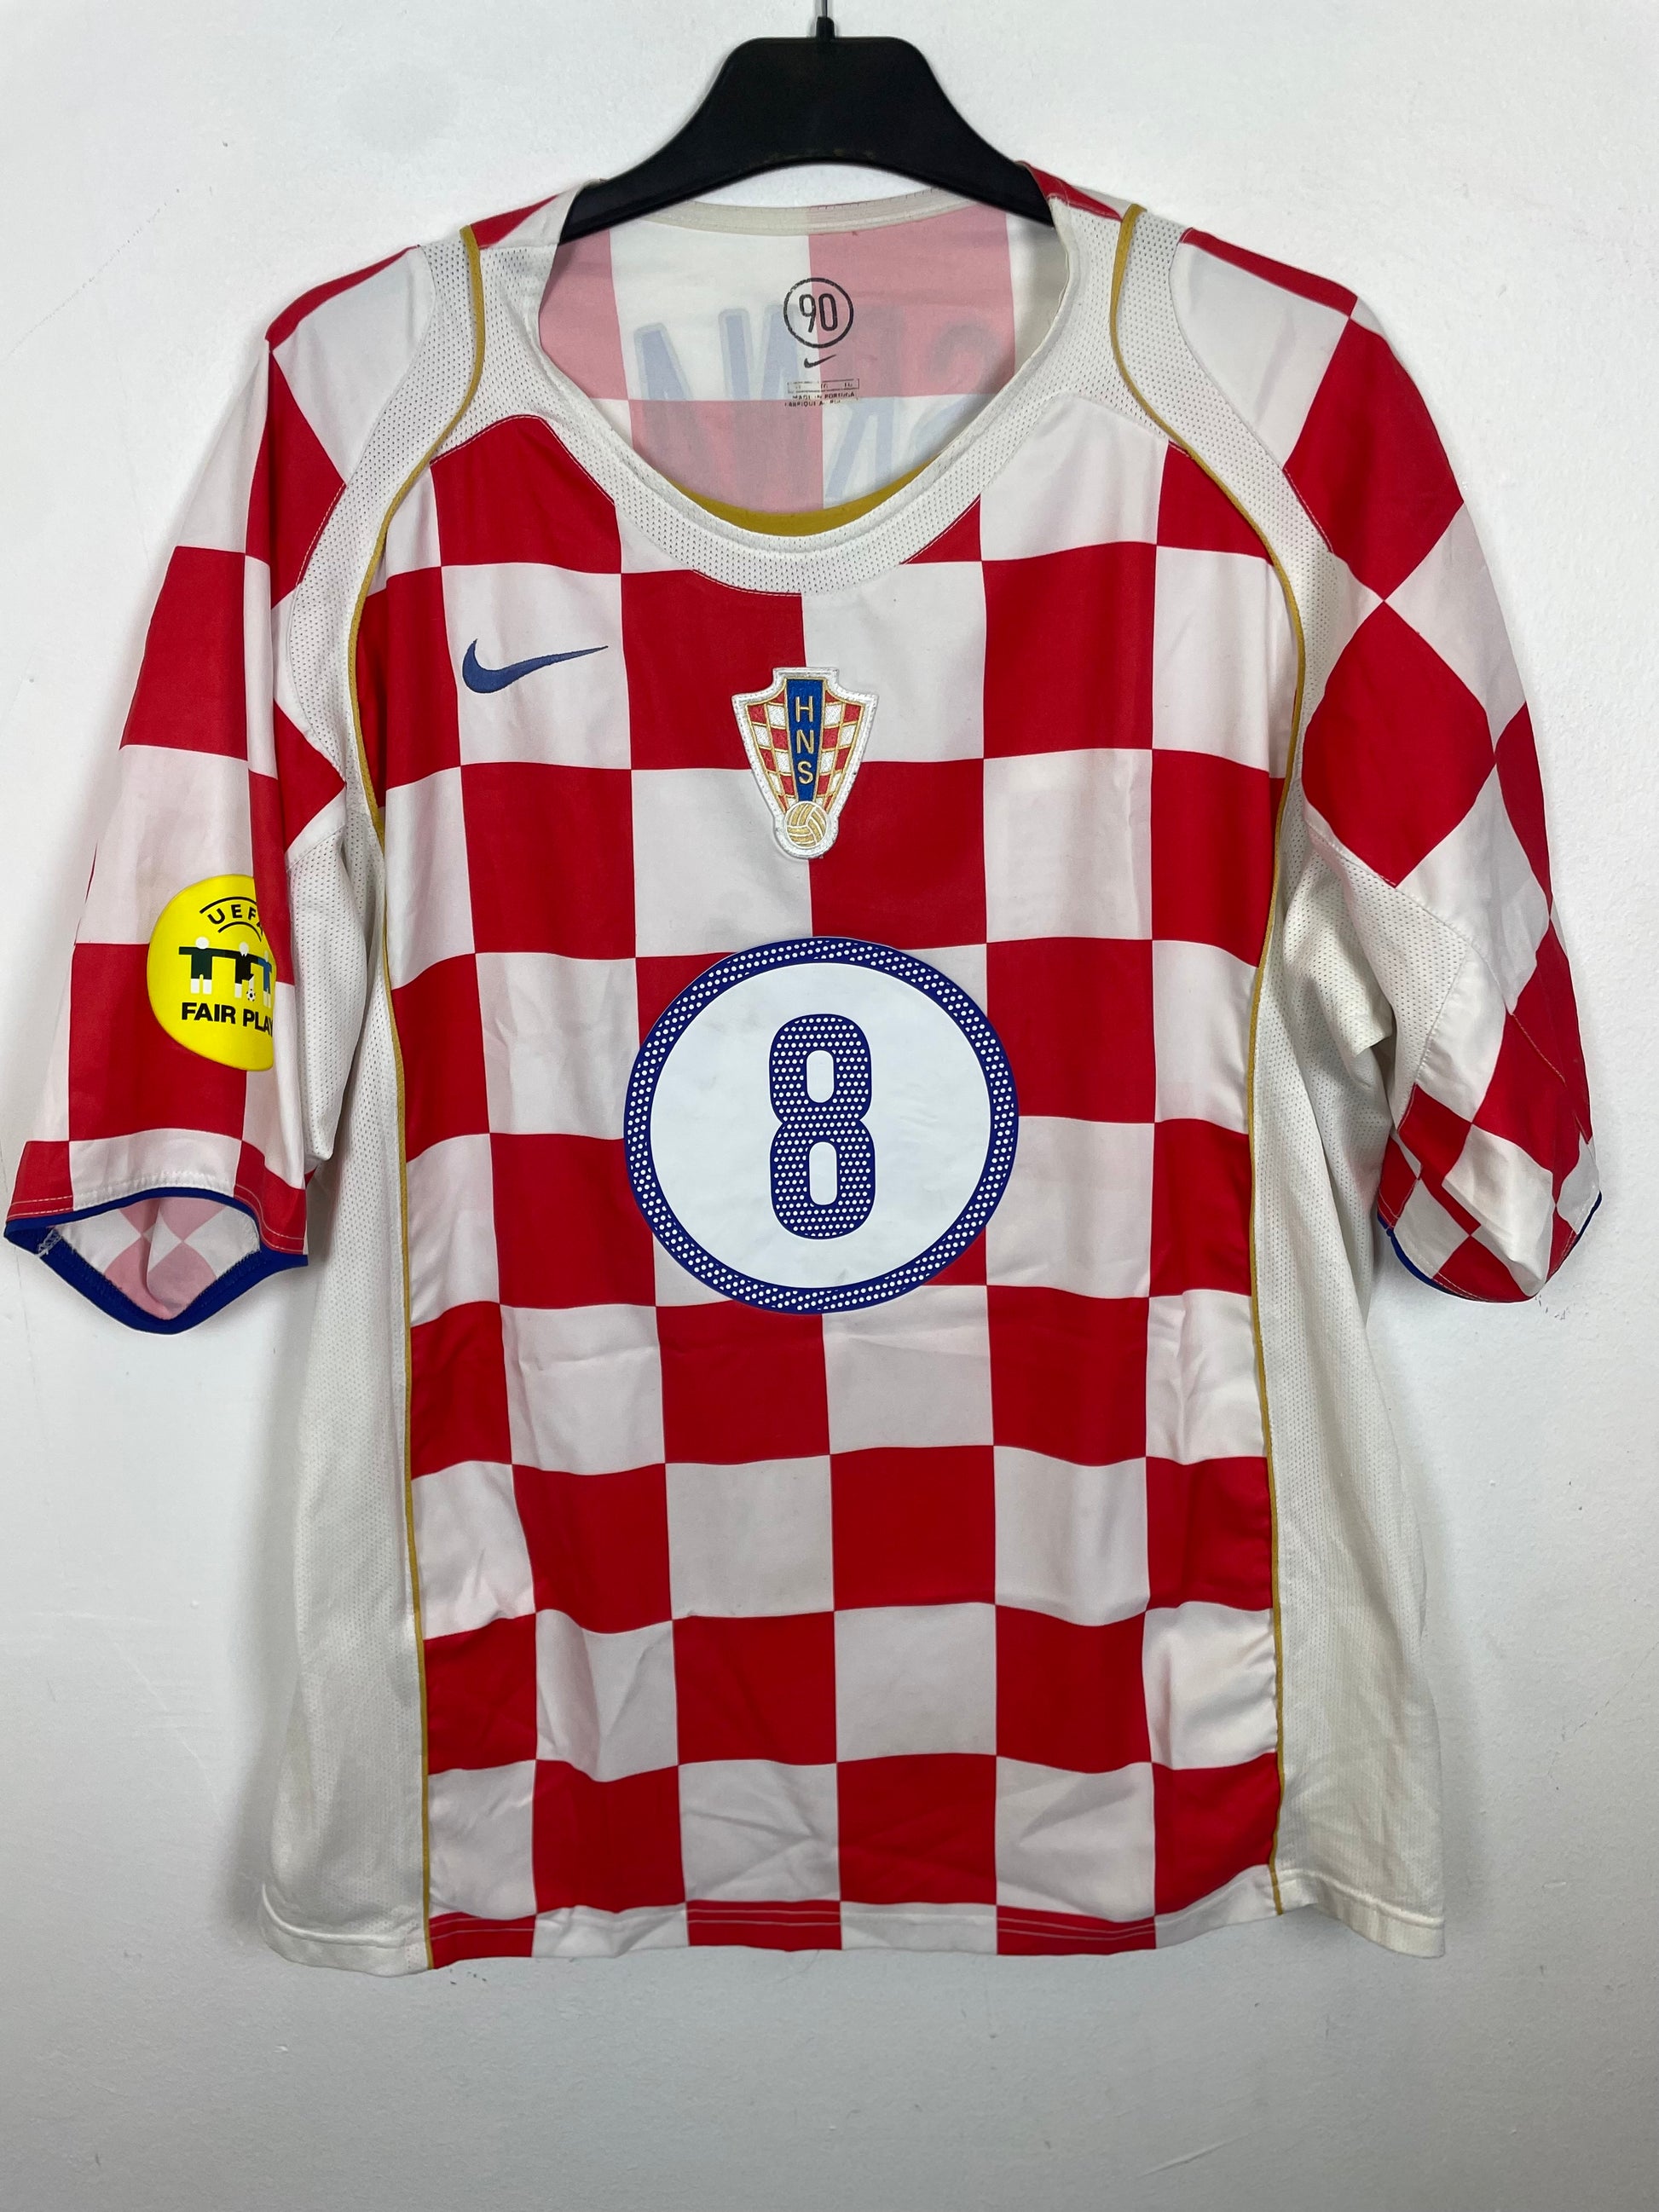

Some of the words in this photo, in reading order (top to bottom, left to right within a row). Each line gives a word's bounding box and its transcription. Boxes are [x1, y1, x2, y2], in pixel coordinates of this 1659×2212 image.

[799, 293, 838, 332] 90
[795, 696, 815, 784] HNS
[182, 1002, 236, 1025] FAIR
[769, 1014, 876, 1240] 8
